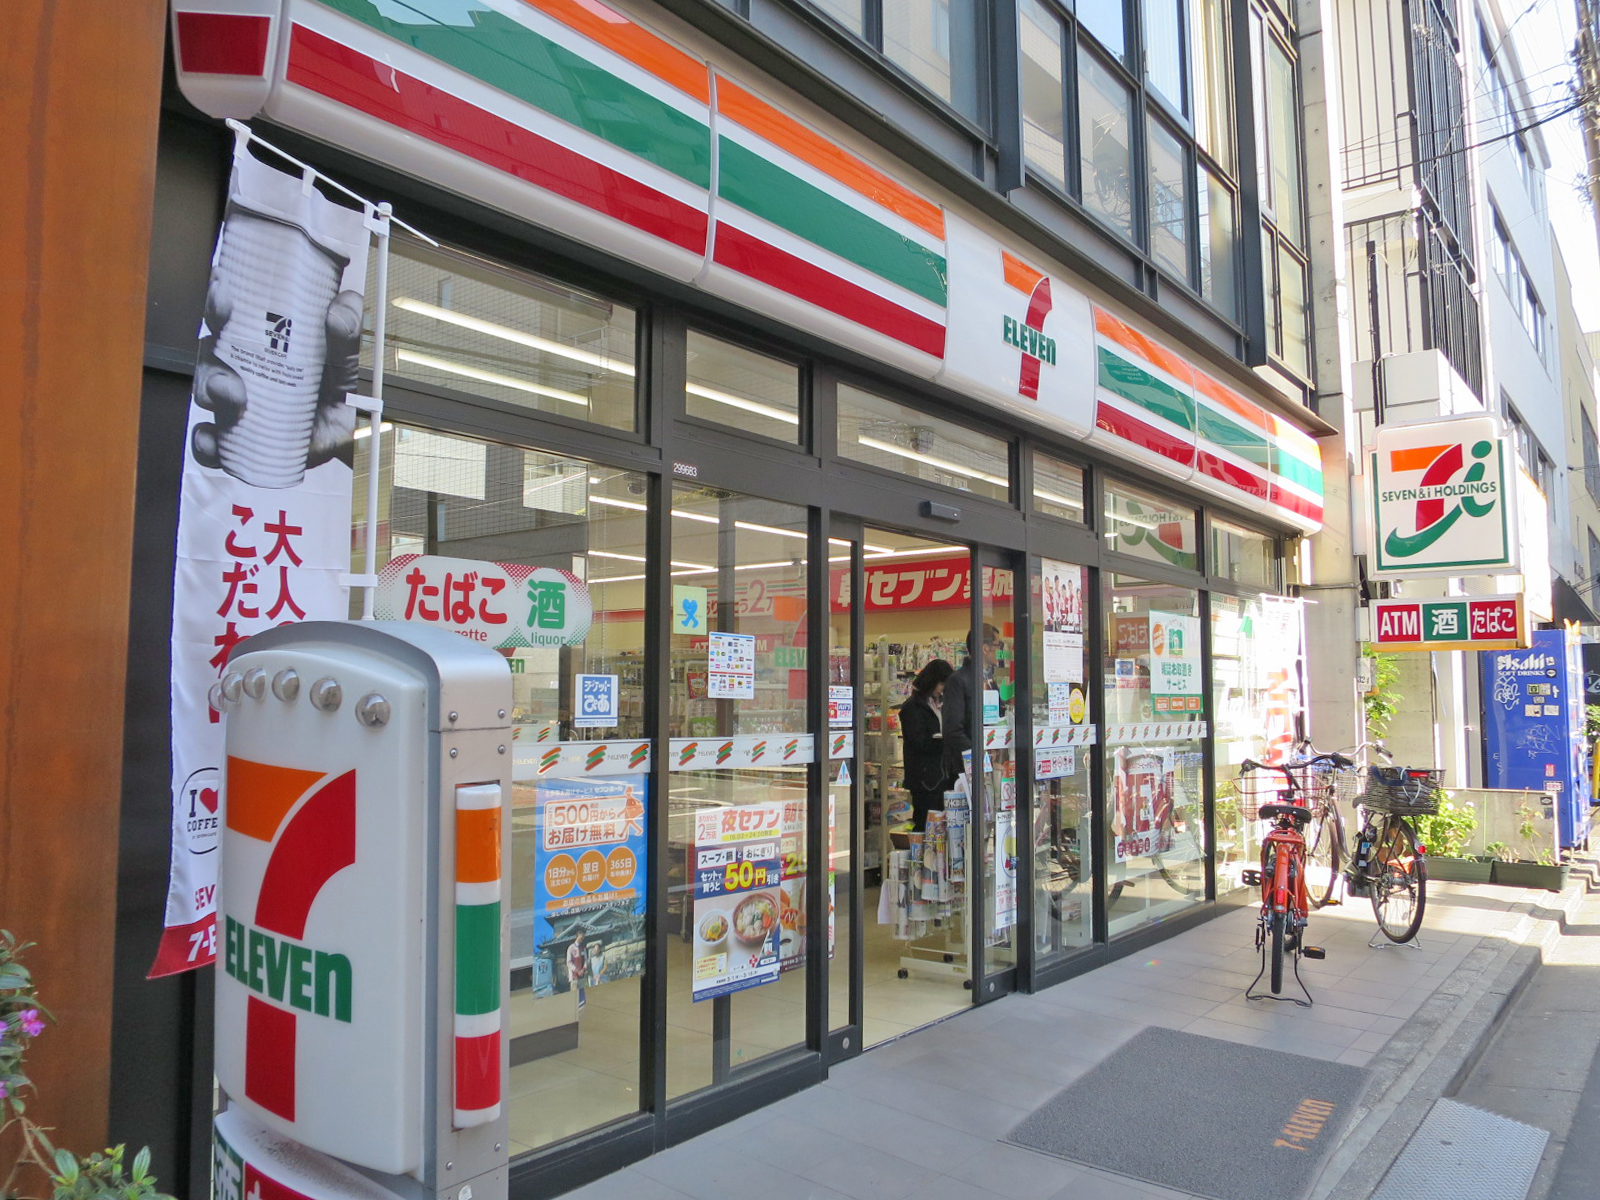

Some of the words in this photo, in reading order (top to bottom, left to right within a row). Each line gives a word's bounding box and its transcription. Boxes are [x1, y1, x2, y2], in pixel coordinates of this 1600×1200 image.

[673, 462, 698, 478] 299683
[1434, 480, 1497, 498] HOLDINGS
[263, 509, 307, 627] 大人
[404, 567, 508, 625] たばこ
[527, 578, 566, 630] 酒
[1380, 610, 1418, 637] ATM
[1431, 608, 1459, 636] 酒
[1472, 605, 1515, 633] たばこ
[530, 631, 566, 647] liquor
[1497, 653, 1546, 671] Asahi
[187, 817, 219, 833] COFFE
[721, 809, 780, 834] 夜セブン
[548, 822, 616, 845] お届け無料
[610, 857, 632, 870] 365日
[746, 845, 773, 859] おにぎり
[582, 861, 599, 874] 翌日
[226, 914, 353, 1024] ELEVEn
